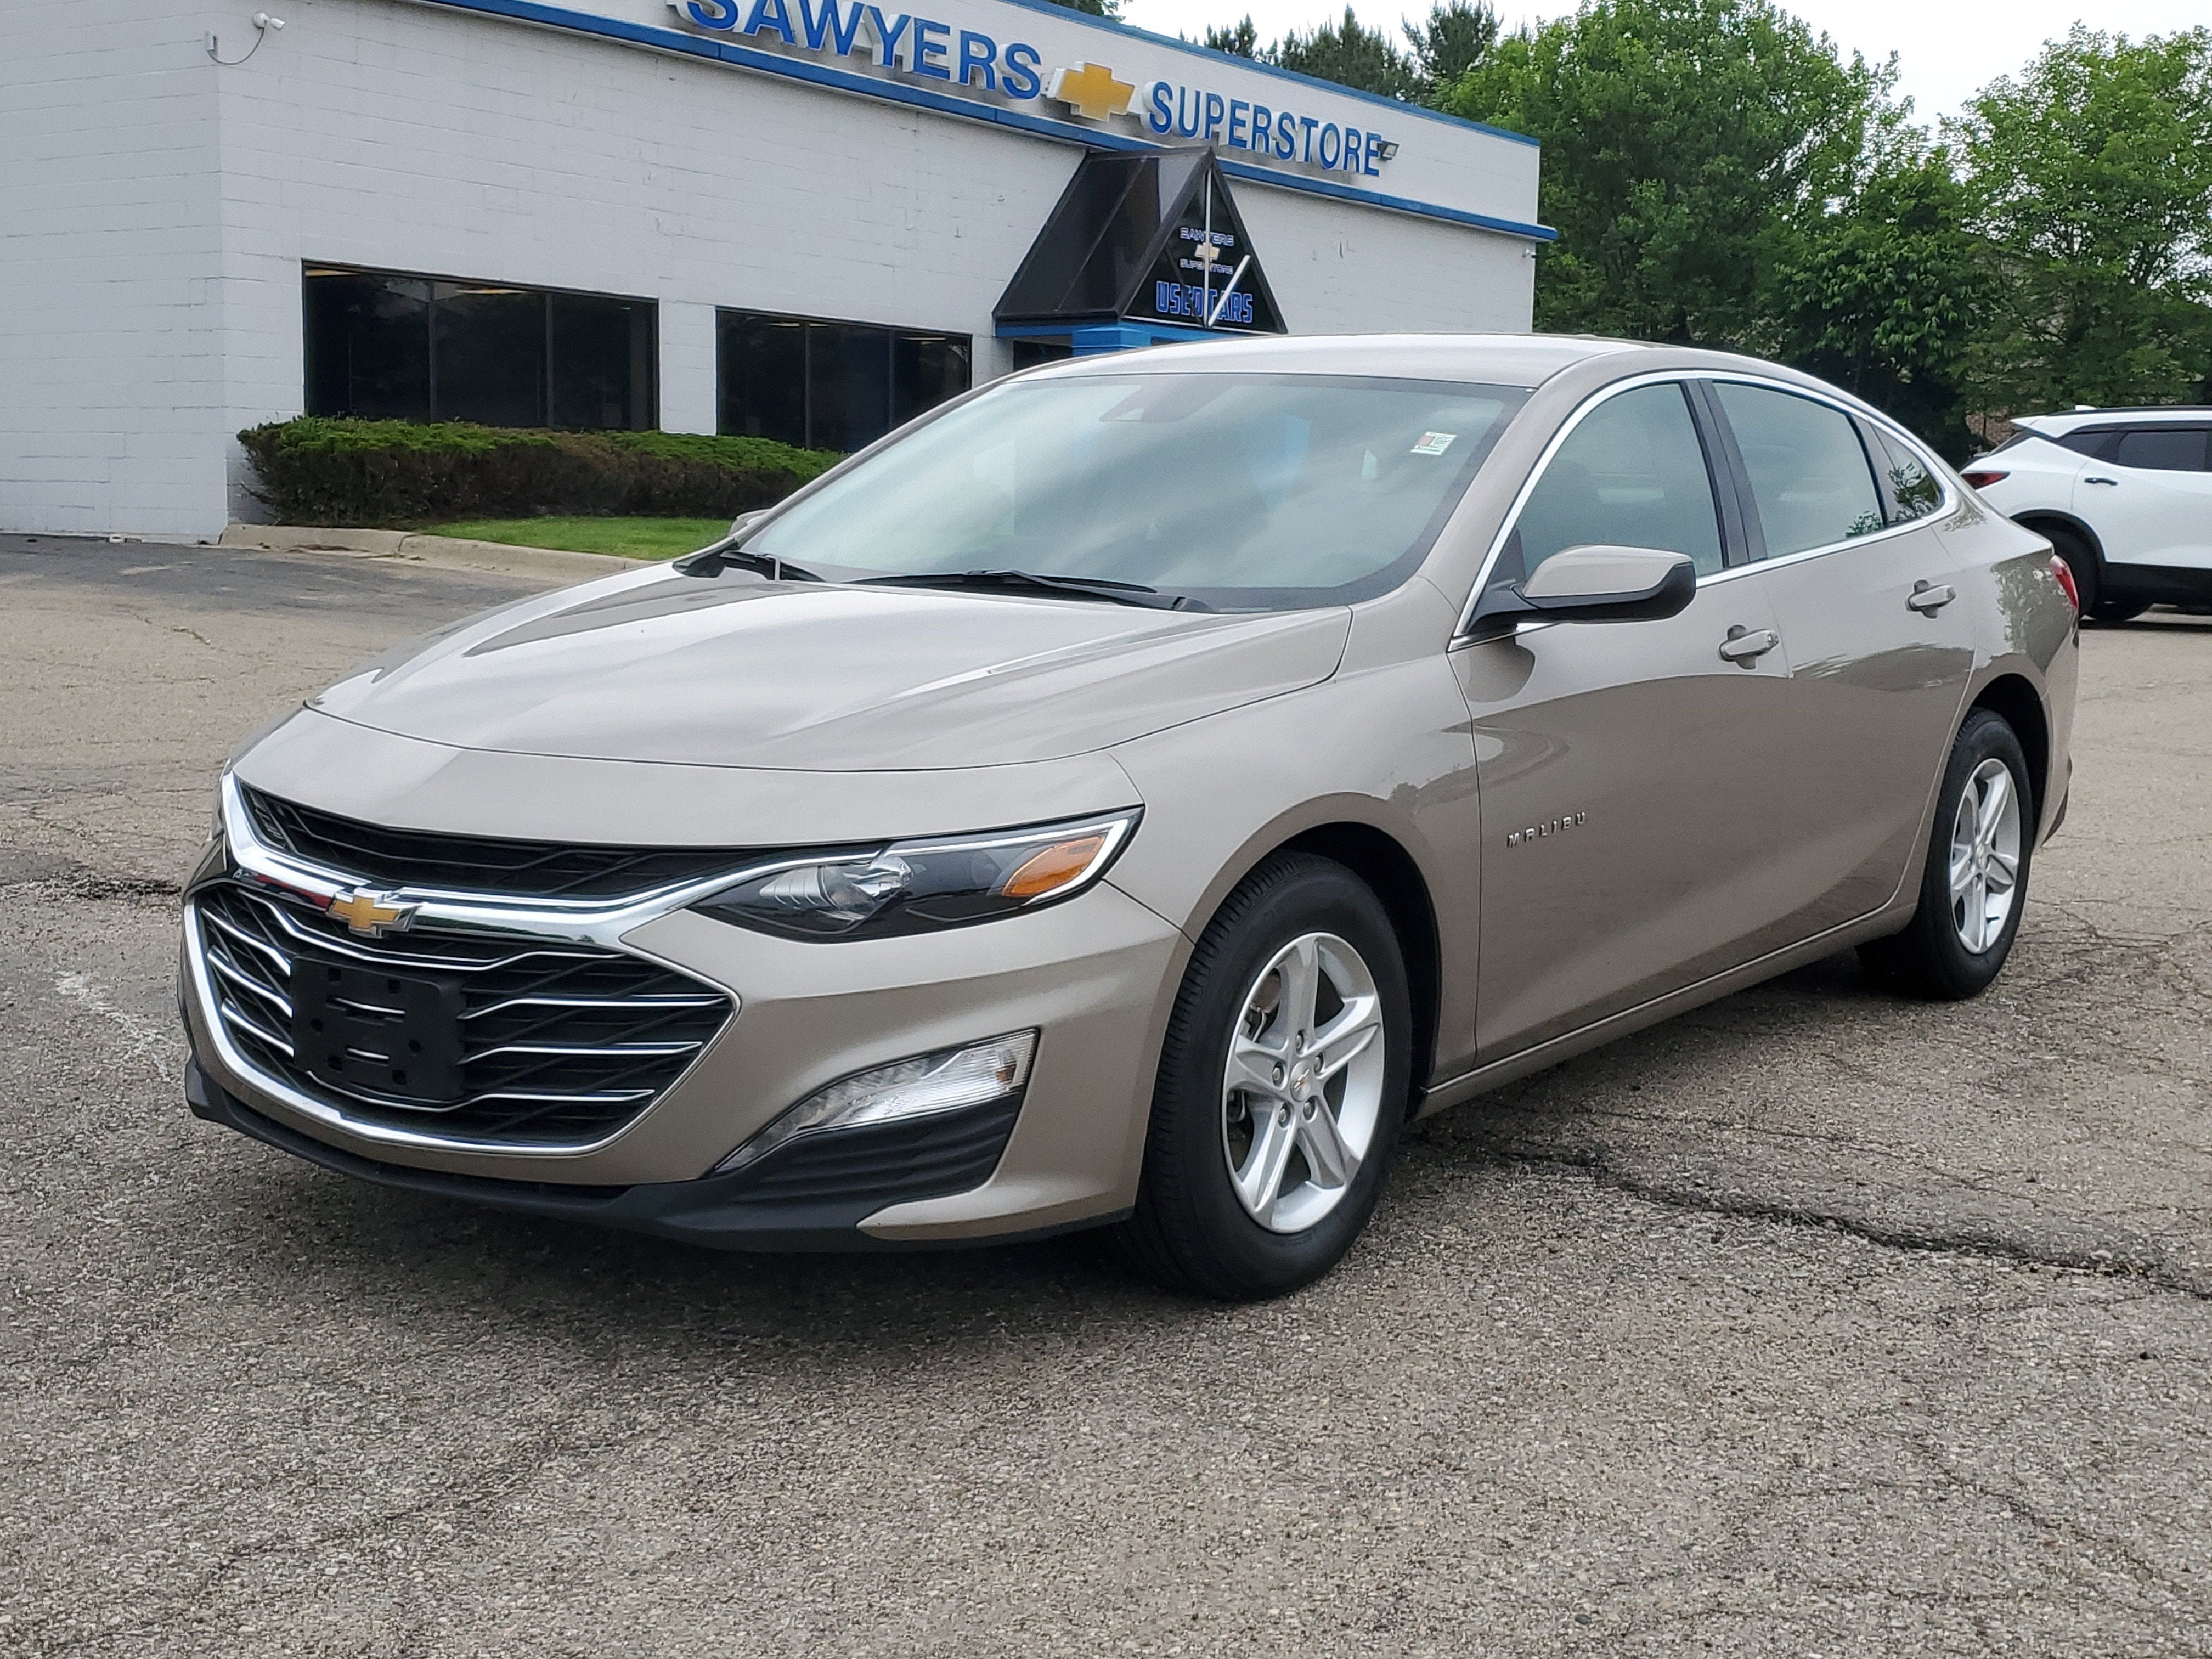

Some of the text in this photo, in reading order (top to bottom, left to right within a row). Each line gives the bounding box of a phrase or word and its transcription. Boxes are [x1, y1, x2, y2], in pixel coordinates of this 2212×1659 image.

[686, 0, 1383, 177] SAWYERS SUPERSTORE
[1156, 280, 1204, 317] USED
[1507, 811, 1586, 848] MALIBU
